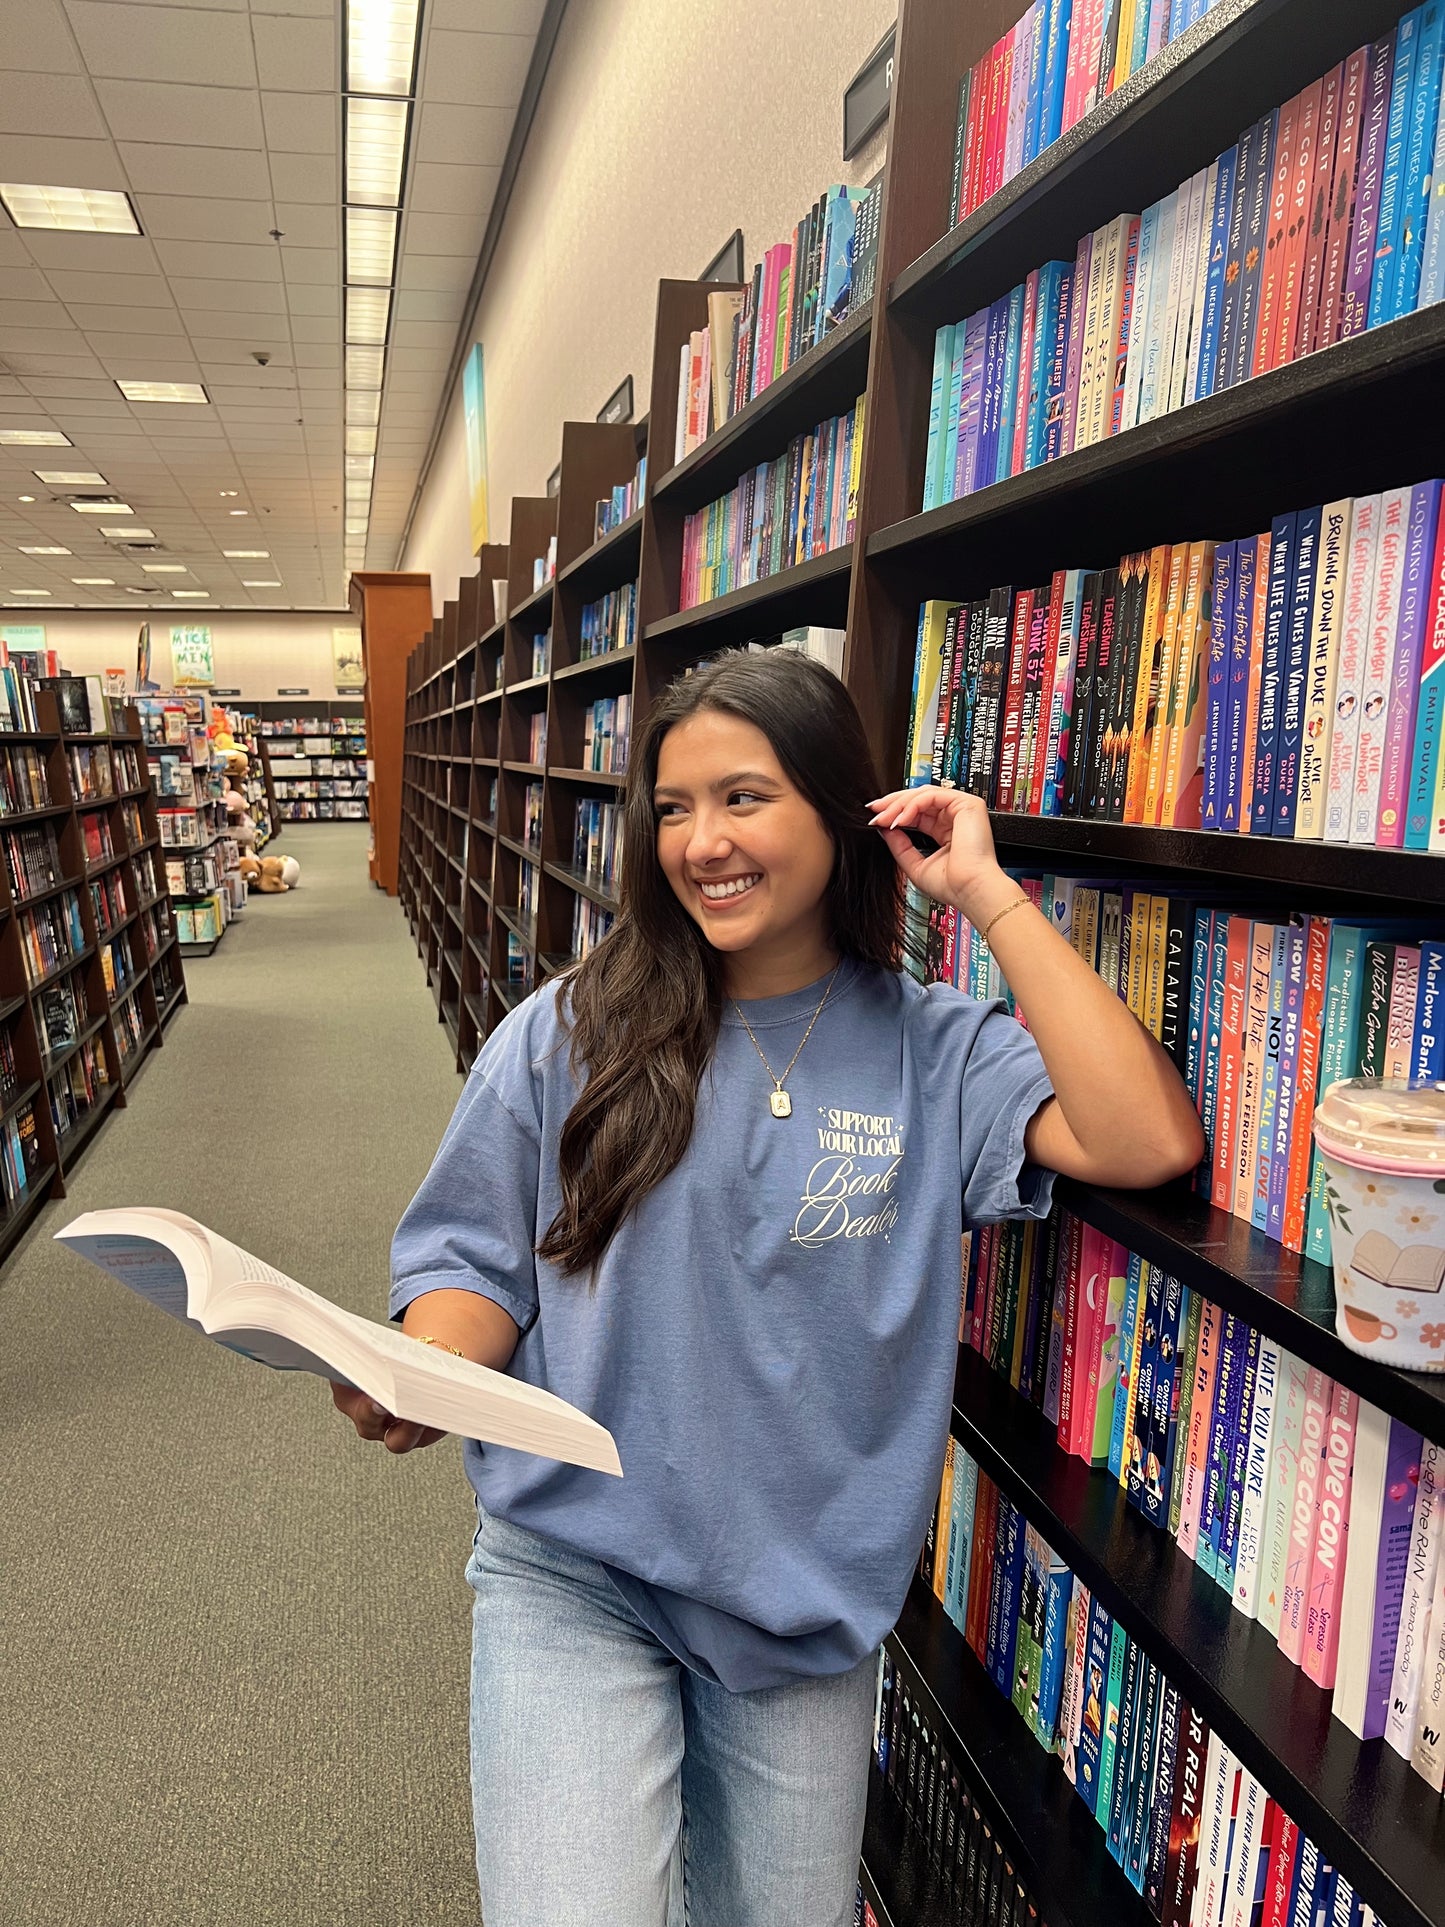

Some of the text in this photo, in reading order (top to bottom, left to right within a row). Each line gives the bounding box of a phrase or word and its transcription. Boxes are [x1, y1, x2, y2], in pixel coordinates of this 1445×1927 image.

[1319, 80, 1336, 171] SAVOR IT
[1342, 60, 1359, 153] SAVOR IT
[1273, 116, 1292, 221] THE CO-OP
[1295, 101, 1313, 208] THE CO-OP
[1354, 43, 1389, 276] Right Where We Left Us
[1217, 167, 1229, 228] SONALI DEV
[1047, 575, 1061, 664] MISCONDUCT
[1058, 600, 1074, 657] UNTIL YOU
[1098, 596, 1115, 666] TEARSMITH
[1157, 556, 1181, 708] BIRDING WITH BENEFITS
[1174, 555, 1200, 710] BIRDING WITH BENEFITS
[1285, 534, 1314, 730] WHEN LIFE GIVES YOU VAMPIRES
[1310, 514, 1344, 707] BRINGING DOWN THE DUKE
[1397, 499, 1427, 689] LOOKING FOR A SIGN
[172, 633, 210, 646] MICE
[177, 652, 209, 664] MEN
[1011, 597, 1028, 685] PENELOPE DOUGLAS
[1027, 607, 1044, 681] PUNK 57
[1077, 599, 1093, 668] TEARSMITH
[1261, 540, 1288, 731] WHEN LIFE GIVES YOU VAMPIRES
[931, 722, 947, 781] HIDEAWAY
[1000, 711, 1019, 788] KILL SWITCH
[1046, 692, 1063, 781] PENELOPE DOUGLAS
[1072, 734, 1081, 767] DOOM
[1094, 708, 1106, 768] ERIN DOOM
[1208, 700, 1220, 796] JENNIFER DUGAN
[1228, 699, 1241, 797] JENNIFER DUGAN
[1256, 760, 1264, 790] DUKE
[1262, 753, 1272, 796] GLORIA
[1279, 759, 1288, 790] DUKE
[1286, 752, 1296, 796] GLORIA
[1300, 743, 1314, 804] DUNMORE
[1311, 757, 1322, 785] EVIE
[1330, 731, 1345, 792] DUNMORE
[1356, 731, 1373, 795] DUNMORE
[1387, 709, 1405, 800] SUSIE DUMOND
[1417, 686, 1438, 802] EMILY DUVALL
[976, 961, 988, 1001] ISSUES
[1120, 913, 1132, 997] Playmaker
[1163, 929, 1183, 1051] CALAMITY
[1223, 958, 1244, 1036] The Nanny
[1389, 955, 1409, 1049] BUSINESS
[1402, 964, 1419, 1045] WHISKY
[1275, 938, 1304, 1156] HOW to PLOT a PAYBACK
[828, 1108, 894, 1136] SUPPORT
[1219, 1054, 1234, 1169] LANA FERGUSON
[1239, 1061, 1254, 1178] LANA FERGUSON
[1256, 979, 1283, 1202] HOW NOT TO FALL IN LOVE
[817, 1128, 905, 1157] YOUR LOCAL
[800, 1155, 903, 1209] Book
[790, 1195, 900, 1249] Dealer
[1159, 1378, 1171, 1434] CONSTANCE
[1219, 1347, 1234, 1415] Interest
[1247, 1349, 1278, 1499] HATE YOU MORE
[1204, 1423, 1224, 1526] Clare Gilmore
[1225, 1443, 1245, 1547] Clare Gilmore
[1419, 1493, 1434, 1530] the
[1238, 1506, 1252, 1572] GILMORE
[1247, 1527, 1258, 1564] LUCY
[1316, 1499, 1341, 1570] CON
[1412, 1531, 1429, 1582] RAIN
[1074, 1592, 1089, 1671] LESSONS
[1307, 1606, 1319, 1636] Glass
[1316, 1607, 1331, 1652] Seressia
[1398, 1587, 1421, 1679] Ariana Godoy
[1181, 1748, 1199, 1818] REAL
[1209, 1752, 1228, 1868] THAT NEVER HAPPENED
[1236, 1780, 1258, 1897] THAT NEVER HAPPENED
